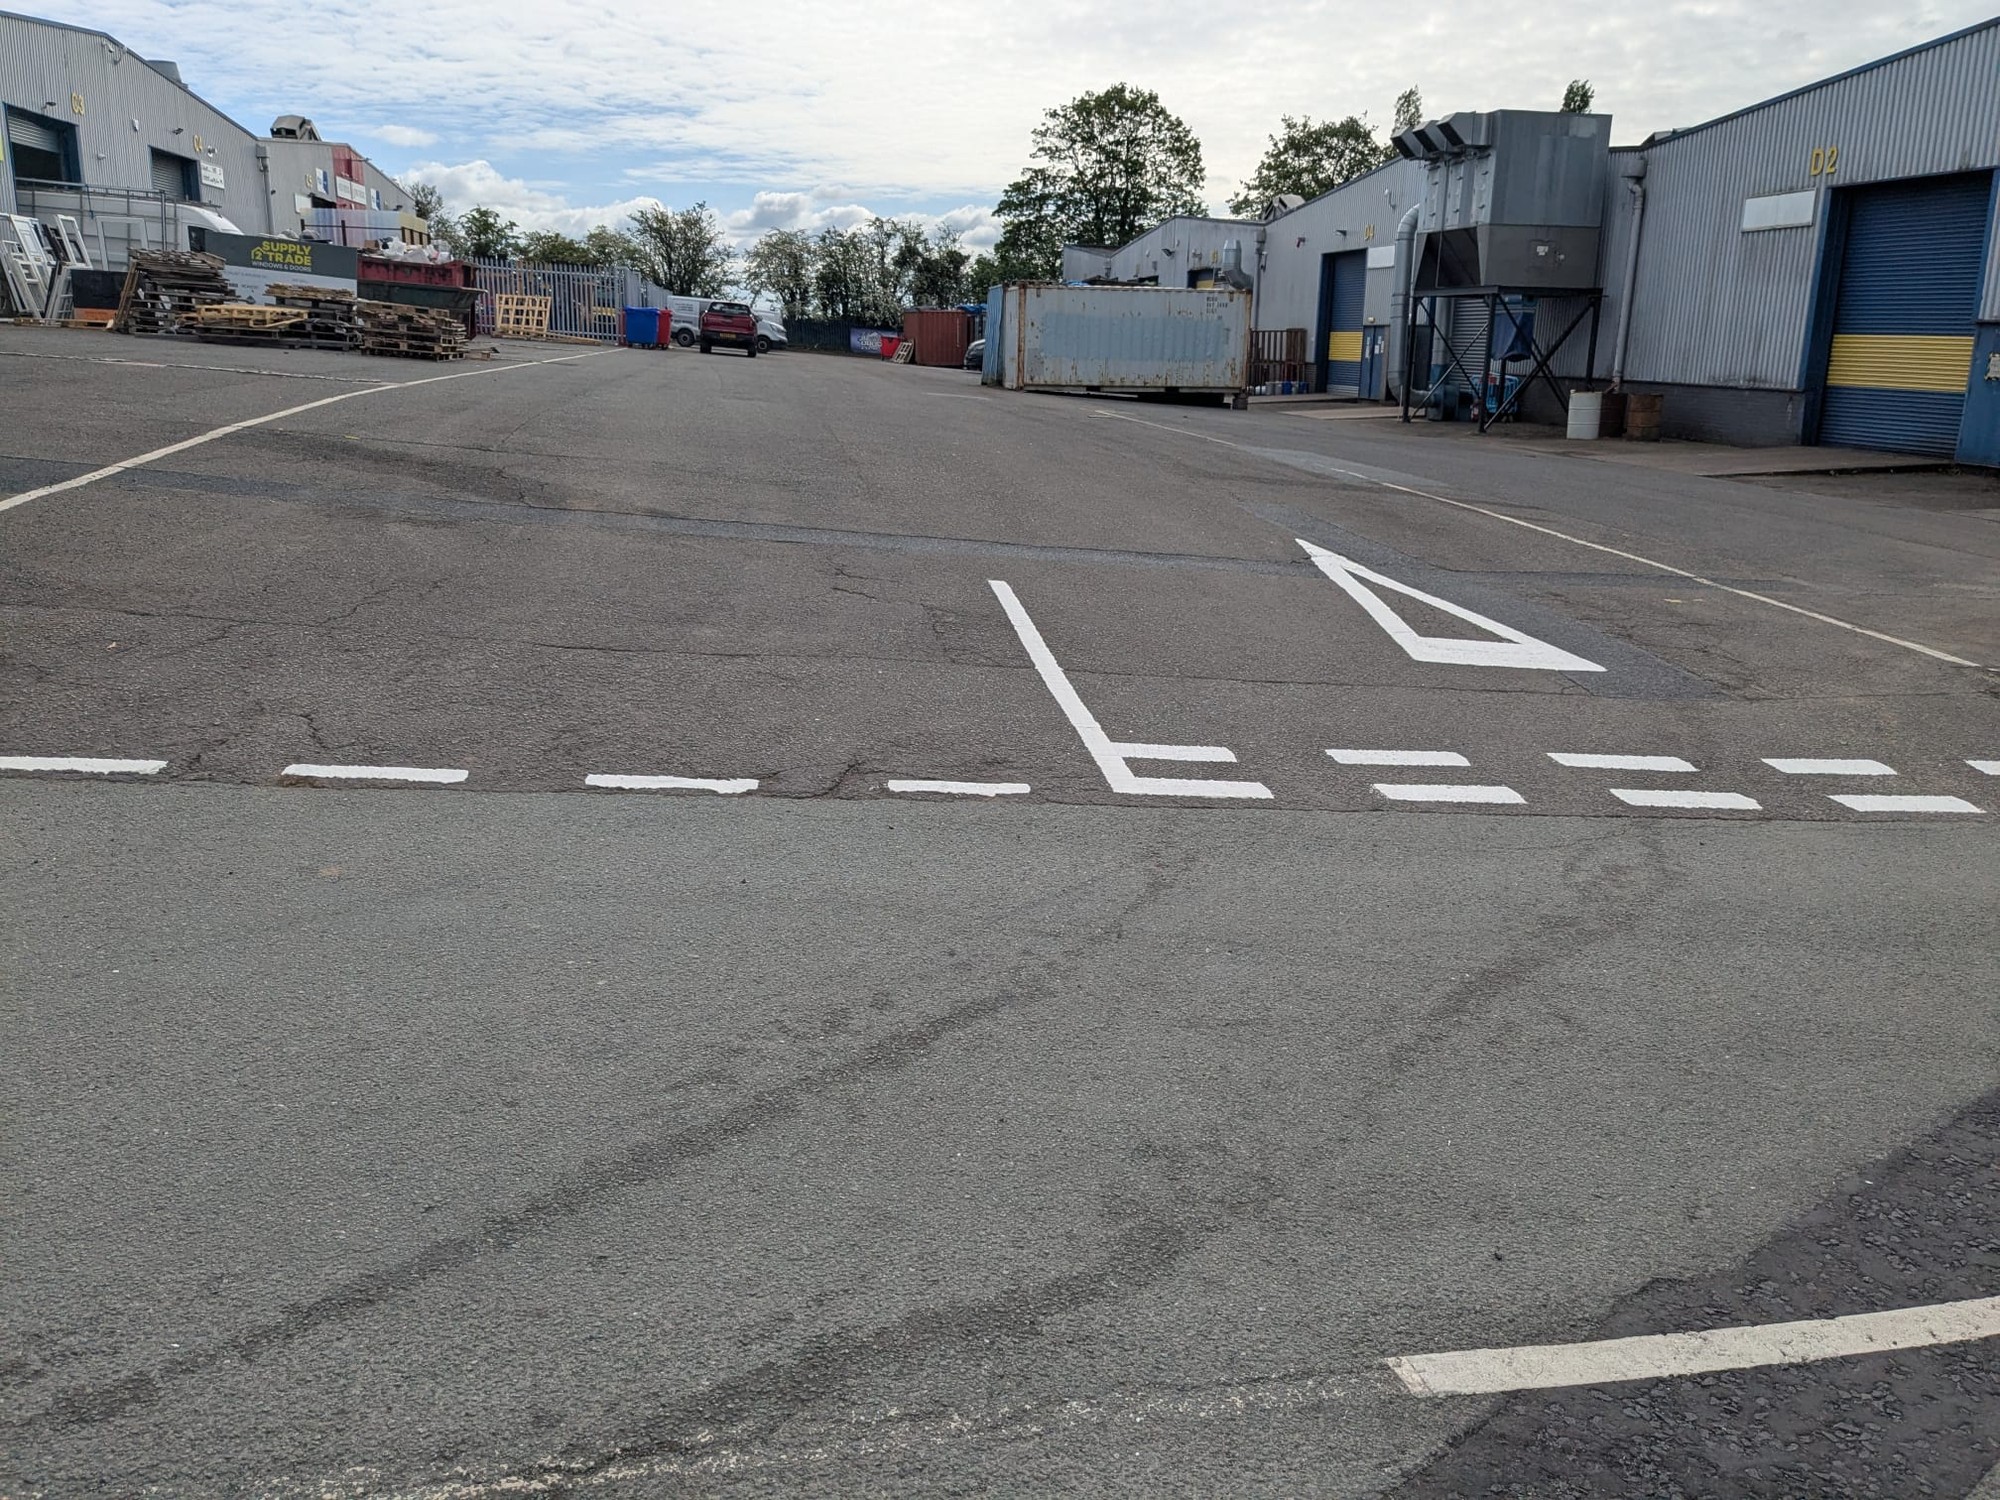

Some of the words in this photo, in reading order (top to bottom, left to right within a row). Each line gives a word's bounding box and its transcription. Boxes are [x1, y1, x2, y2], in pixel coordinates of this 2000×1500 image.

[72, 92, 85, 115] C3
[1810, 146, 1838, 176] D2
[262, 240, 311, 255] SUPPLY
[252, 261, 283, 269] WINDOWS
[255, 251, 263, 260] 2
[267, 252, 312, 266] TRADE
